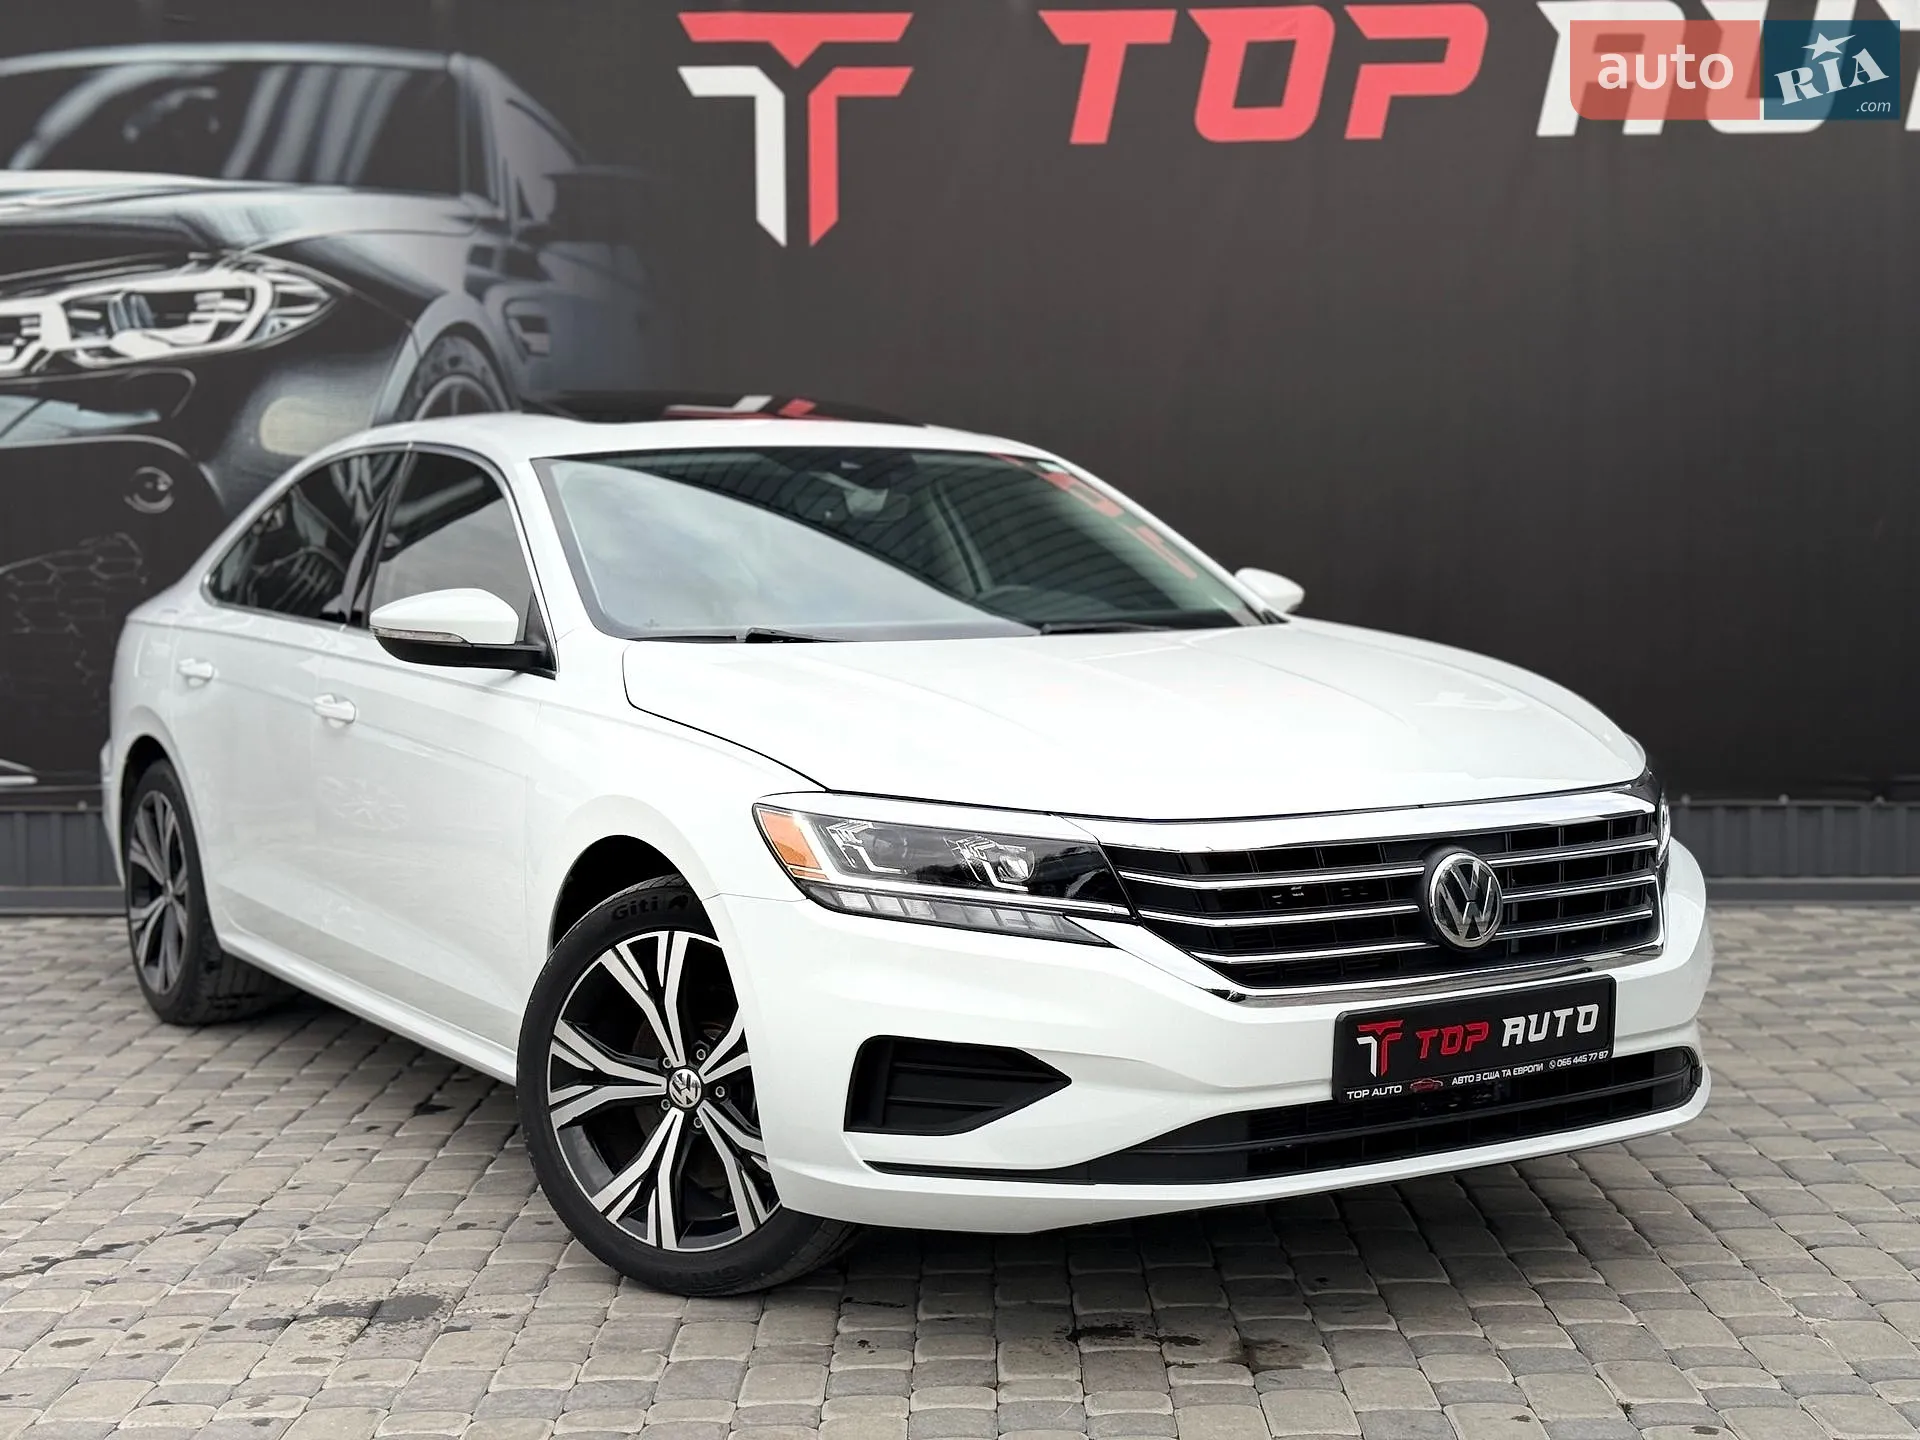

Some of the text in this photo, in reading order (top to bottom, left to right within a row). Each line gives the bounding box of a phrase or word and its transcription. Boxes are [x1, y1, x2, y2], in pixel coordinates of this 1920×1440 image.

[1037, 3, 1490, 145] TOP
[612, 895, 659, 921] Giti
[1415, 1003, 1600, 1060] TOP AUTO
[1588, 1052, 1598, 1062] 77
[1451, 1074, 1475, 1086] АВТО
[1346, 1085, 1403, 1100] TOP AUTO
